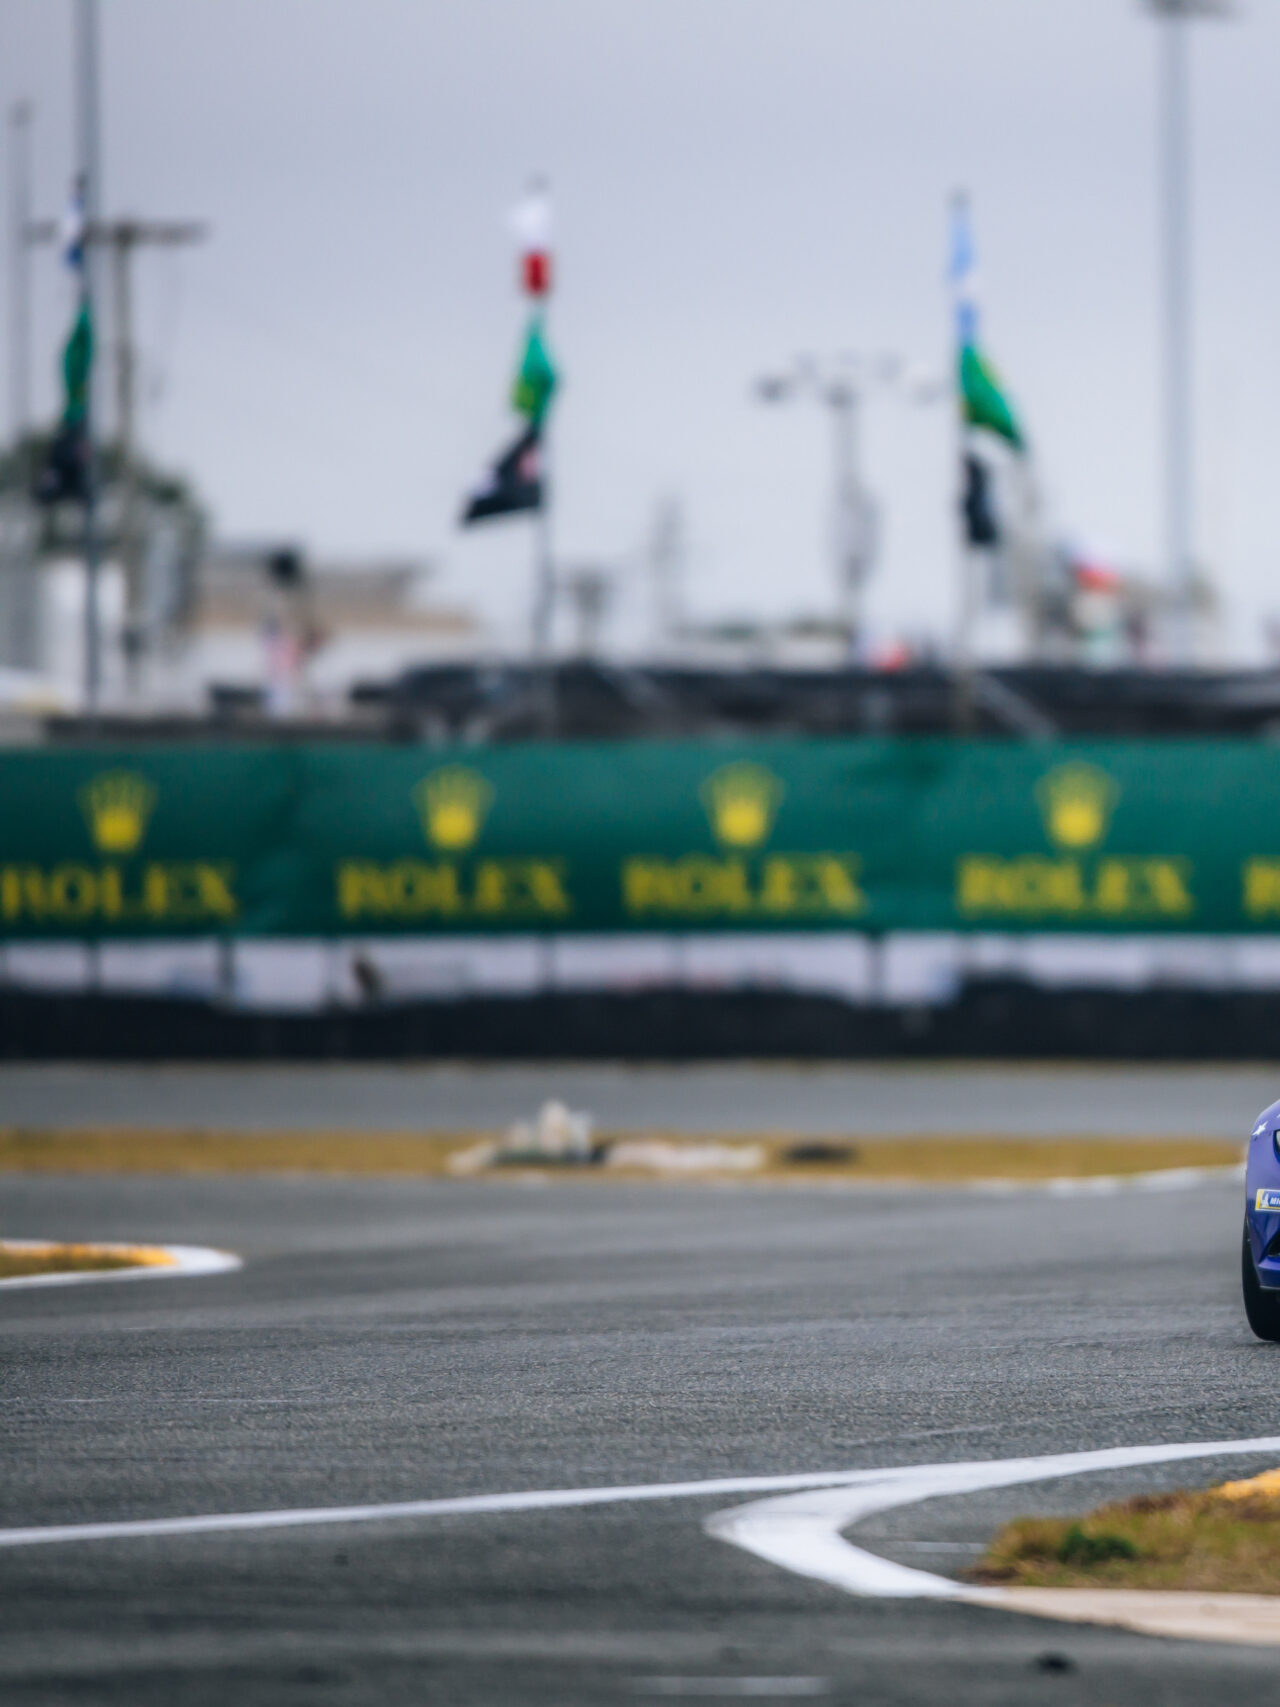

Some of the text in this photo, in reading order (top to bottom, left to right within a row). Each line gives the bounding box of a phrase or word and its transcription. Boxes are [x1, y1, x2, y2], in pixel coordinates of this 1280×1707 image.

[0, 862, 238, 919] ROLEX
[338, 860, 568, 915] ROLEX
[623, 854, 862, 914] ROLEX
[956, 855, 1192, 917] ROLEX
